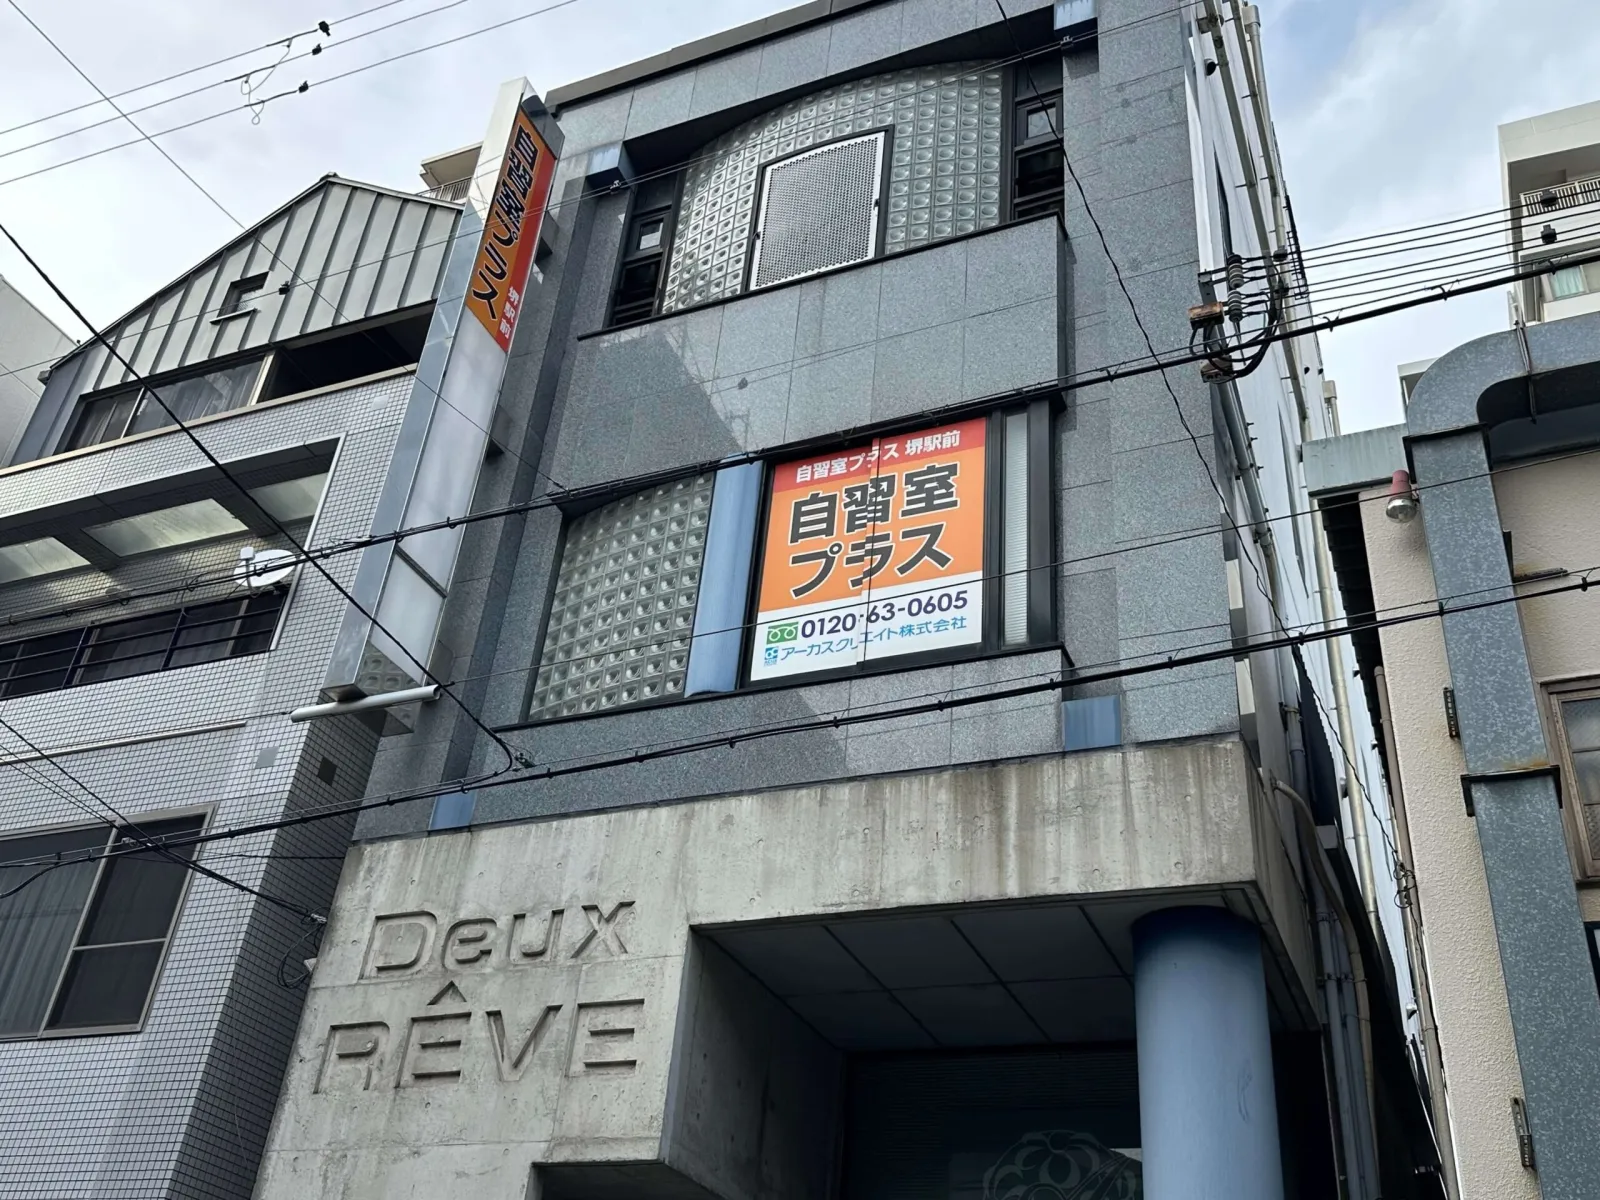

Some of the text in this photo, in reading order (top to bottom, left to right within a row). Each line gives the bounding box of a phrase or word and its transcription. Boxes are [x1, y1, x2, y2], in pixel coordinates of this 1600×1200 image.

[472, 124, 539, 321] 自習室プラス
[499, 286, 520, 340] 堺駅前
[795, 429, 961, 483] 自習室プラス 堺駅前
[788, 461, 961, 545] 自習室
[789, 521, 954, 599] プラス
[360, 900, 636, 981] Deux
